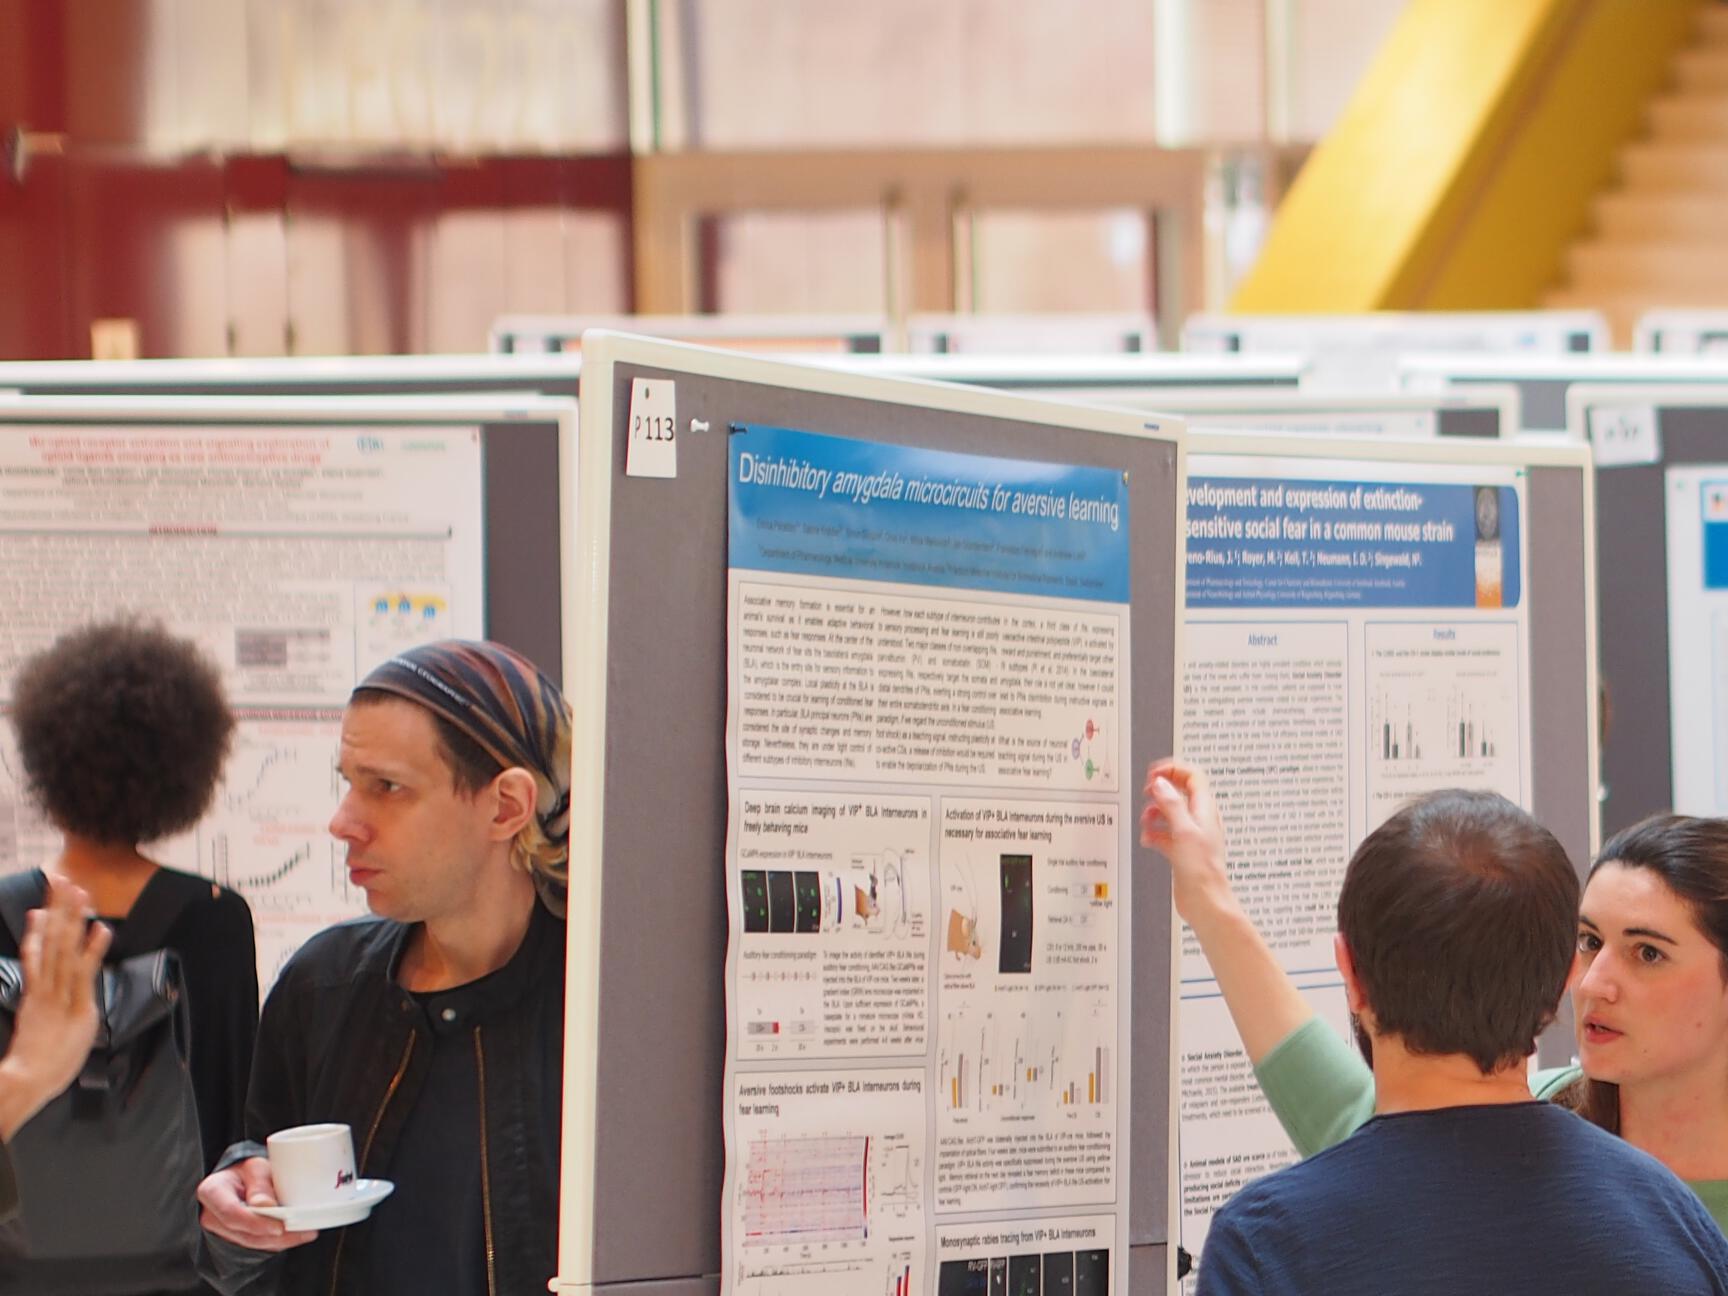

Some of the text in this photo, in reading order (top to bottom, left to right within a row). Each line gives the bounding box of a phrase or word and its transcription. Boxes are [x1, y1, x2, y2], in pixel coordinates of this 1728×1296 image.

[738, 454, 1118, 532] Disinhibitory amygdala microcircuits for aversive learning
[1186, 485, 1257, 513] velopment
[1259, 487, 1283, 507] and
[1286, 487, 1347, 514] expression
[1349, 489, 1361, 509] of
[1245, 520, 1280, 539] social
[1283, 520, 1307, 539] fear
[1310, 521, 1321, 540] in
[1324, 526, 1331, 540] a
[1333, 526, 1382, 540] common
[1384, 526, 1420, 541] mouse
[1422, 522, 1454, 541] strain
[1246, 634, 1278, 646] Abstract
[1432, 628, 1456, 640] Results
[744, 802, 760, 816] Deep
[764, 803, 780, 814] brain
[784, 804, 808, 814] calcium
[810, 804, 836, 818] imaging
[839, 806, 845, 816] of
[865, 807, 878, 816] BLA
[921, 809, 928, 818] in
[944, 810, 973, 820] Activation
[975, 811, 980, 820] of
[996, 812, 1007, 821] BLA
[1009, 812, 1043, 822] interneurons
[1044, 814, 1062, 825] during
[1064, 814, 1072, 823] the
[1074, 815, 1095, 824] aversive
[744, 822, 809, 835] freely behaving mice
[944, 830, 973, 840] necessary
[984, 829, 1015, 839] associative
[1017, 830, 1027, 839] fear
[1029, 830, 1052, 842] learning
[738, 1084, 766, 1095] Aversive
[768, 1084, 802, 1094] footshocks
[806, 1083, 828, 1093] activate
[847, 1083, 860, 1092] BLA
[862, 1082, 899, 1092] interneurons
[902, 1082, 922, 1094] during
[738, 1105, 780, 1117] fear learning
[1182, 1178, 1242, 1194] producing social deficits
[940, 1234, 980, 1249] Monosynaptic
[982, 1234, 998, 1244] rabies
[1000, 1233, 1019, 1245] tracing
[1020, 1232, 1033, 1241] from
[1048, 1231, 1059, 1240] BLA
[1061, 1229, 1096, 1239] interneurons
